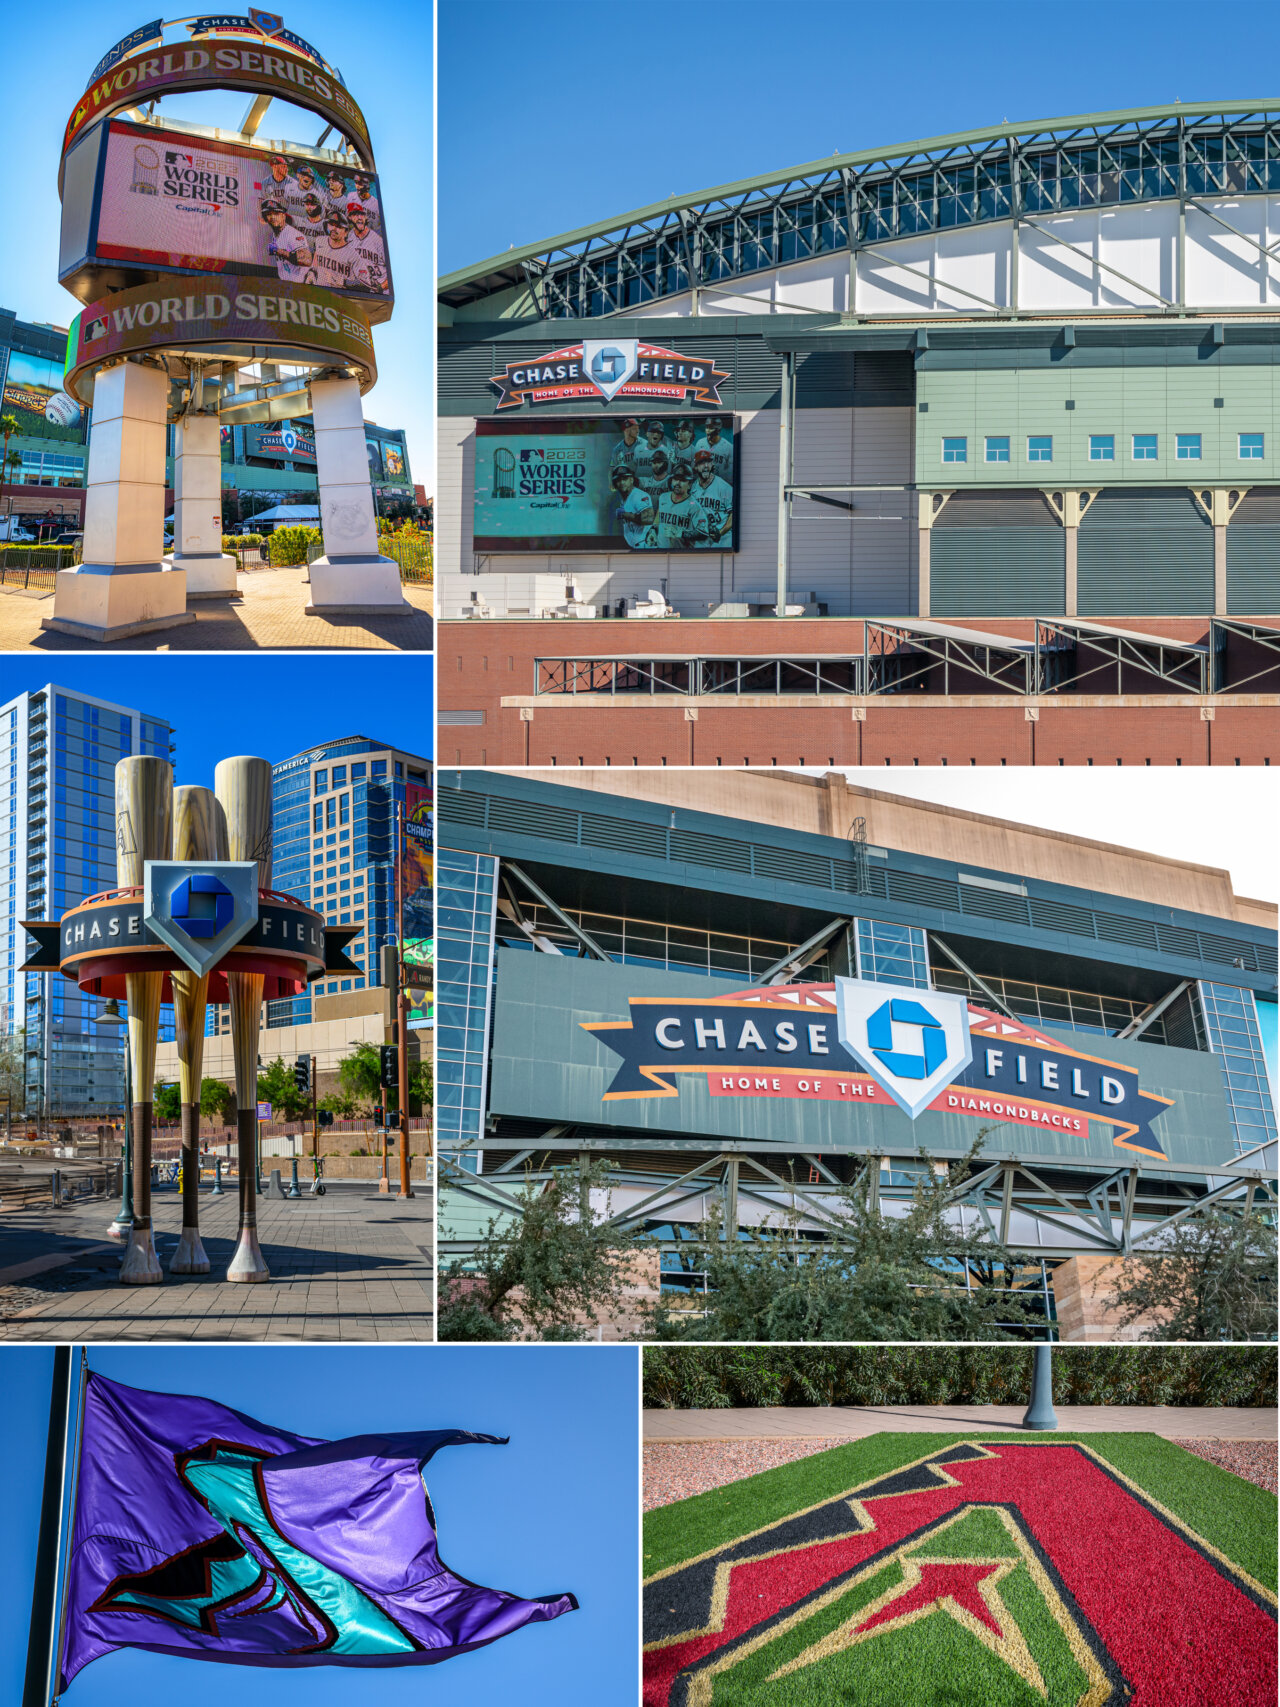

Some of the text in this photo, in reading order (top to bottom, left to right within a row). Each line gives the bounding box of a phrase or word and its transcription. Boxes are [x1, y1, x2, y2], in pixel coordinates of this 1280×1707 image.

[203, 19, 318, 57] CHASE FIELD
[90, 48, 333, 106] WORLD SERIES
[164, 165, 239, 191] WORLD
[196, 159, 238, 174] 2023
[163, 180, 239, 206] SERIES
[113, 293, 231, 333] WORLD
[235, 293, 341, 333] SERIES
[512, 362, 705, 384] CHASE FIELD
[535, 390, 558, 398] HOME
[622, 386, 681, 396] DIAMONDBACKS
[263, 437, 282, 445] CHASE
[546, 451, 586, 460] 2023
[519, 463, 586, 479] WORLD
[519, 478, 586, 495] SERIES
[279, 757, 309, 774] AMERICA
[64, 915, 326, 950] CHASE FIELD
[655, 1016, 1126, 1106] CHASE FIELD
[722, 1076, 1082, 1132] HOME OF THE DIAMONDBACKS
